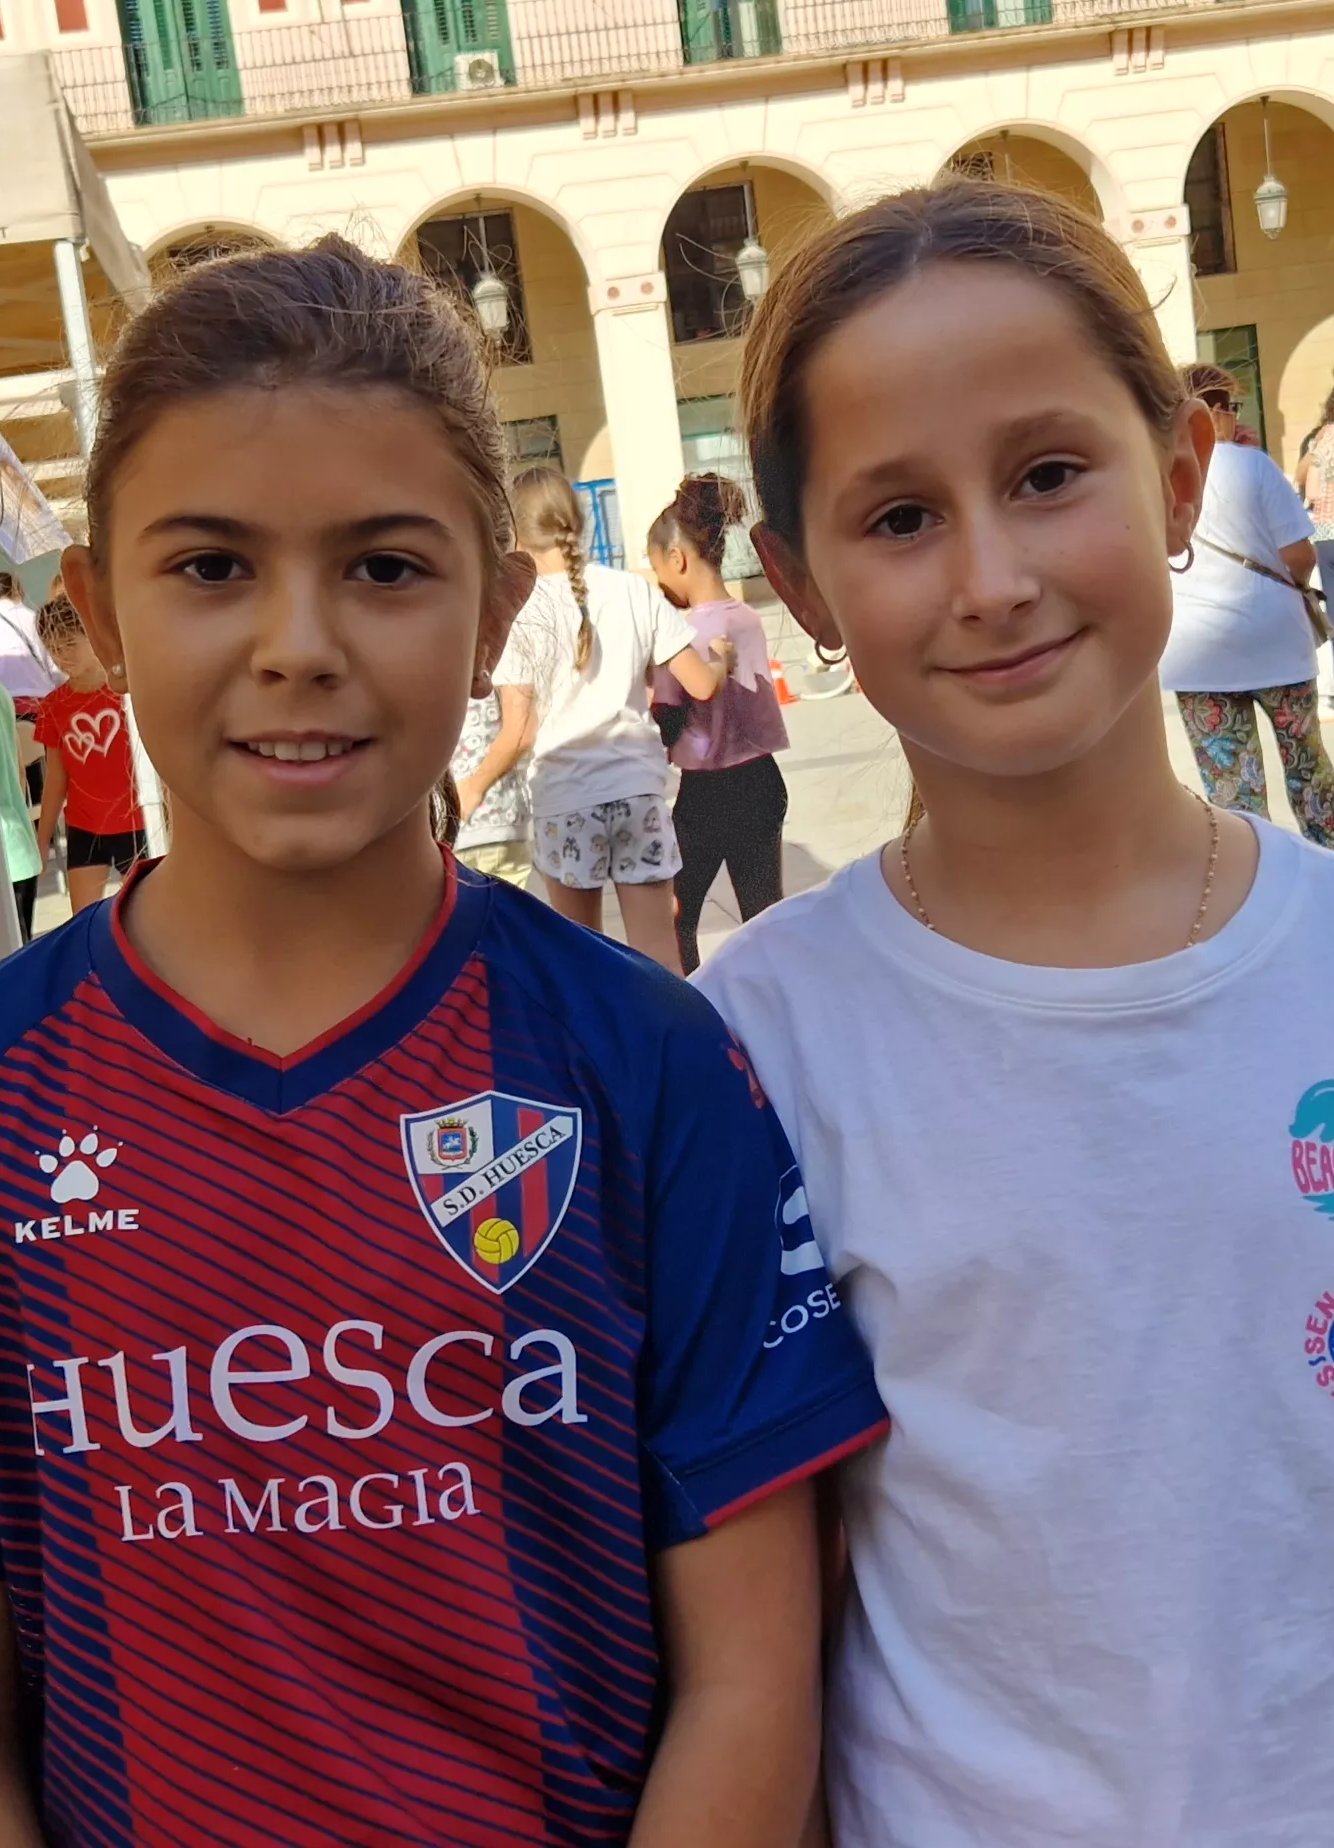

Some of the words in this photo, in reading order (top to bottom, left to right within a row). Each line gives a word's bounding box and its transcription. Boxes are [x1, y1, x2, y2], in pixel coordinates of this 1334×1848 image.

[442, 1185, 485, 1216] S.D.
[482, 1125, 566, 1188] HUESCA
[14, 1208, 140, 1244] KELME
